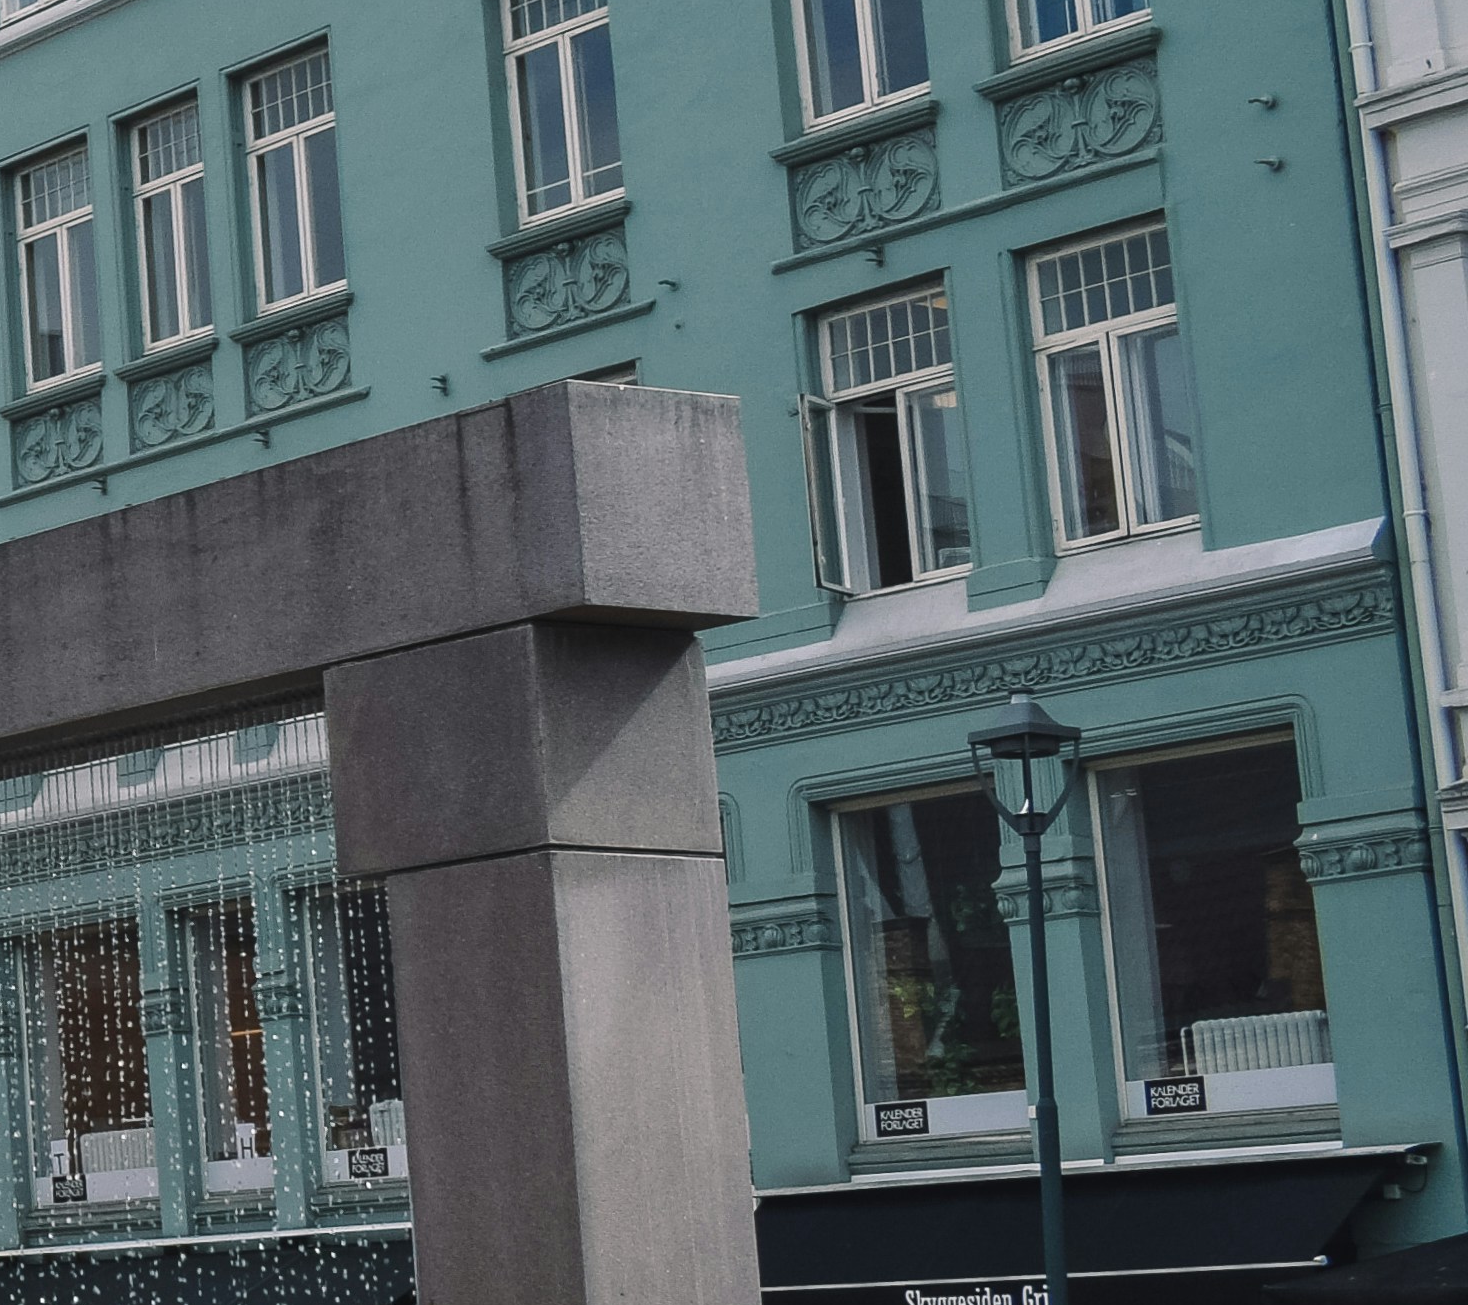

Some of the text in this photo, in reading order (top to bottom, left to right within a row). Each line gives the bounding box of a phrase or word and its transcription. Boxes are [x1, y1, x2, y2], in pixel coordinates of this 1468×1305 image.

[1150, 1083, 1200, 1097] KALENDER
[1151, 1094, 1201, 1109] FORLAGET
[879, 1107, 924, 1120] KALENDER
[880, 1118, 924, 1131] FORLAGET
